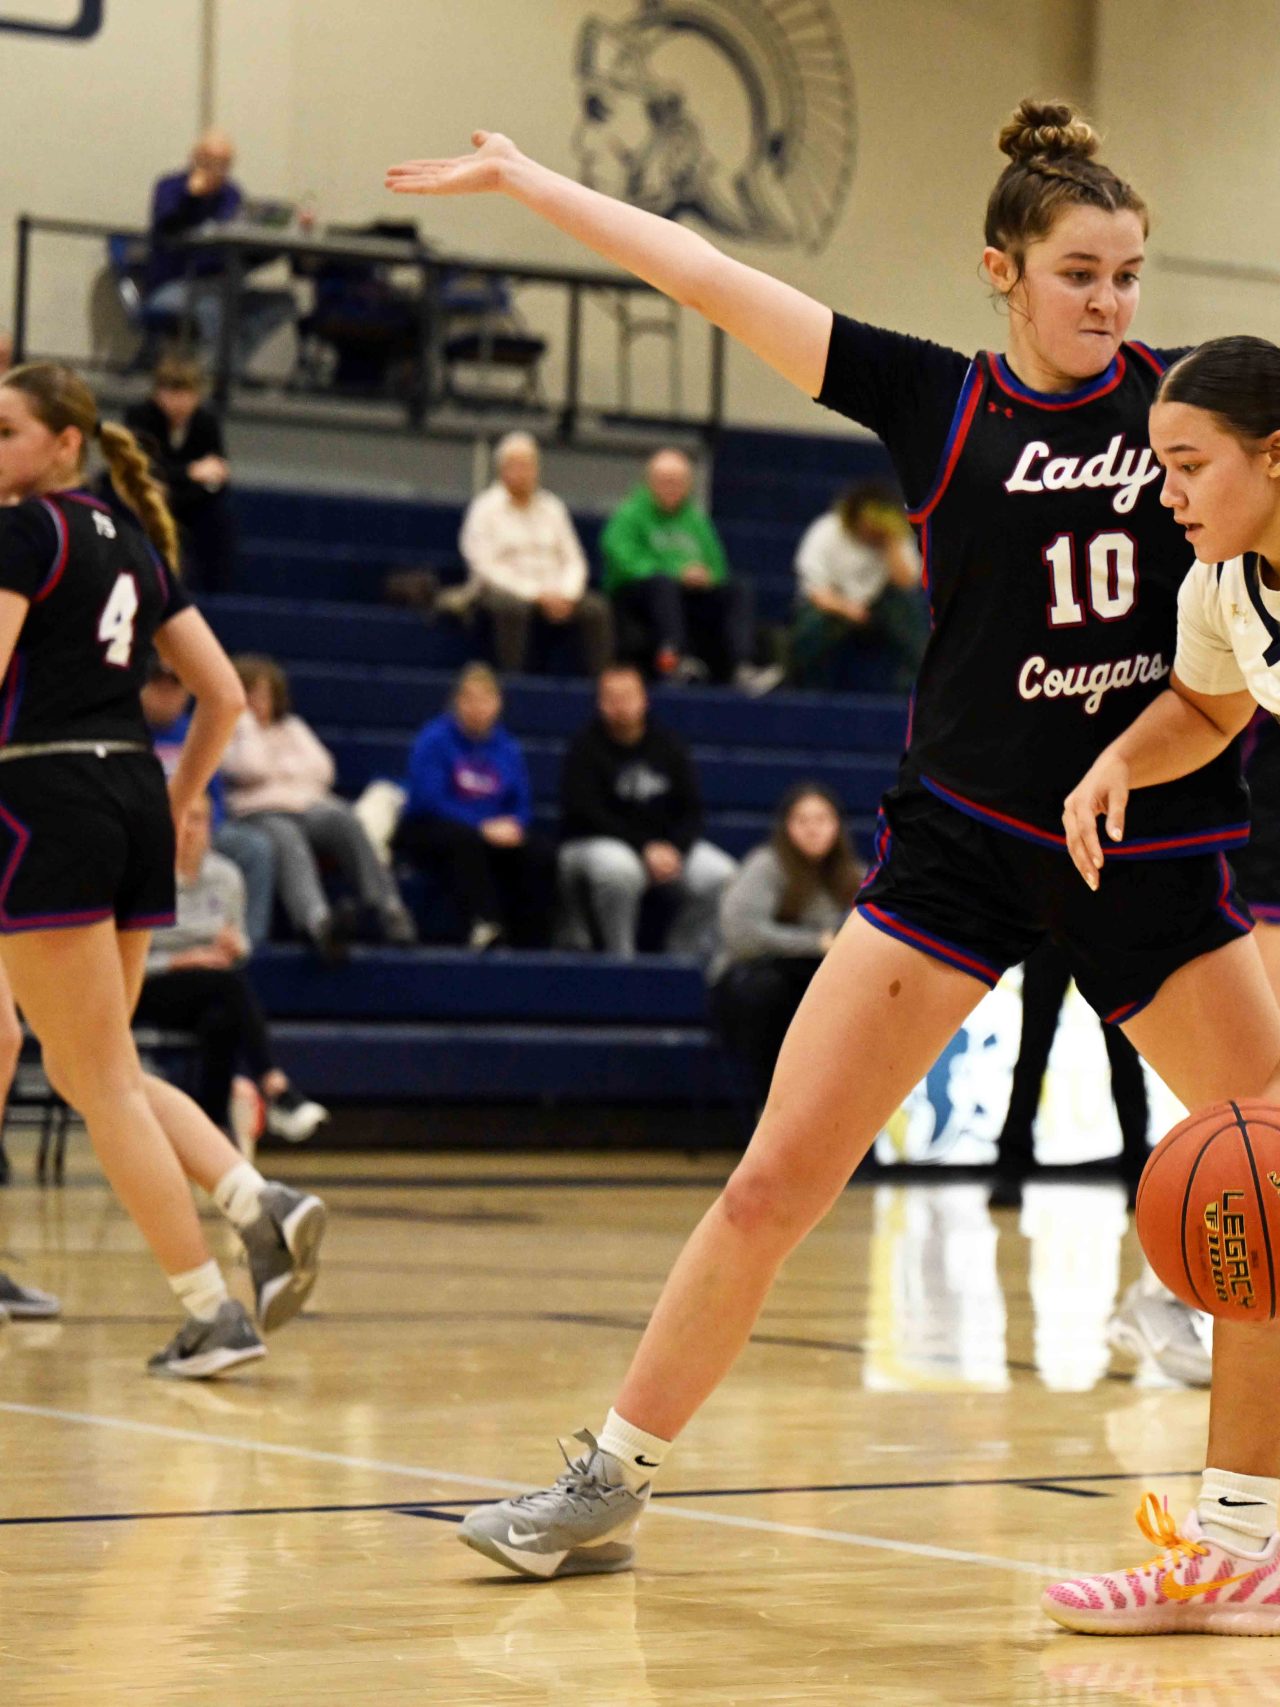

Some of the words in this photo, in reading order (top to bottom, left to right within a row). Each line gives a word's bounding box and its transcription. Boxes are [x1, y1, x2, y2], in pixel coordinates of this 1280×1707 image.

[1005, 433, 1161, 514] Lady
[97, 571, 139, 670] 4
[1044, 531, 1137, 628] 10
[1018, 653, 1168, 715] Cougars
[1222, 1189, 1256, 1310] LEGACY
